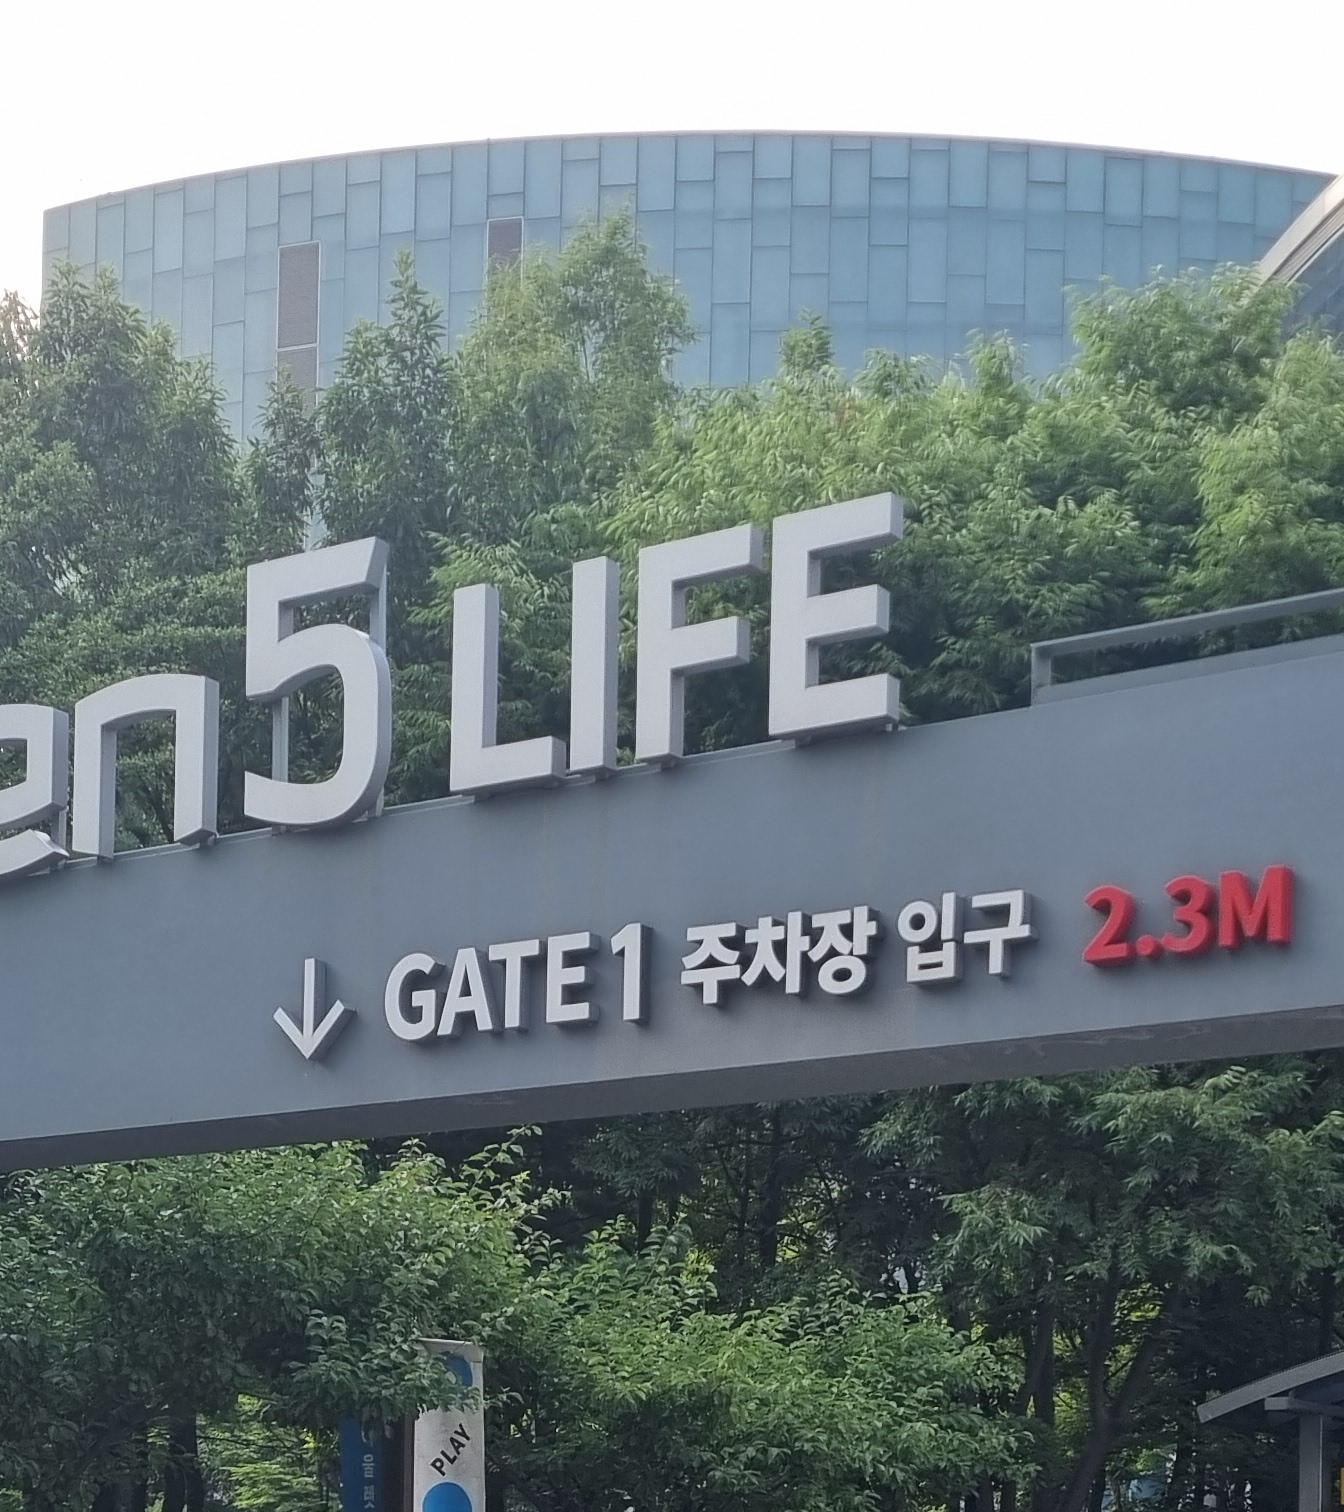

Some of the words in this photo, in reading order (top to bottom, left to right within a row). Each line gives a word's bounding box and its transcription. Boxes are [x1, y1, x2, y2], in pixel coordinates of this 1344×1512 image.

[450, 491, 904, 796] LIFE
[384, 931, 601, 1043] GATE
[610, 922, 654, 1022] 1
[680, 904, 877, 1005] 주차장
[897, 889, 1038, 986] 입구
[1083, 864, 1294, 967] 2.3M
[430, 1424, 471, 1477] PLAY
